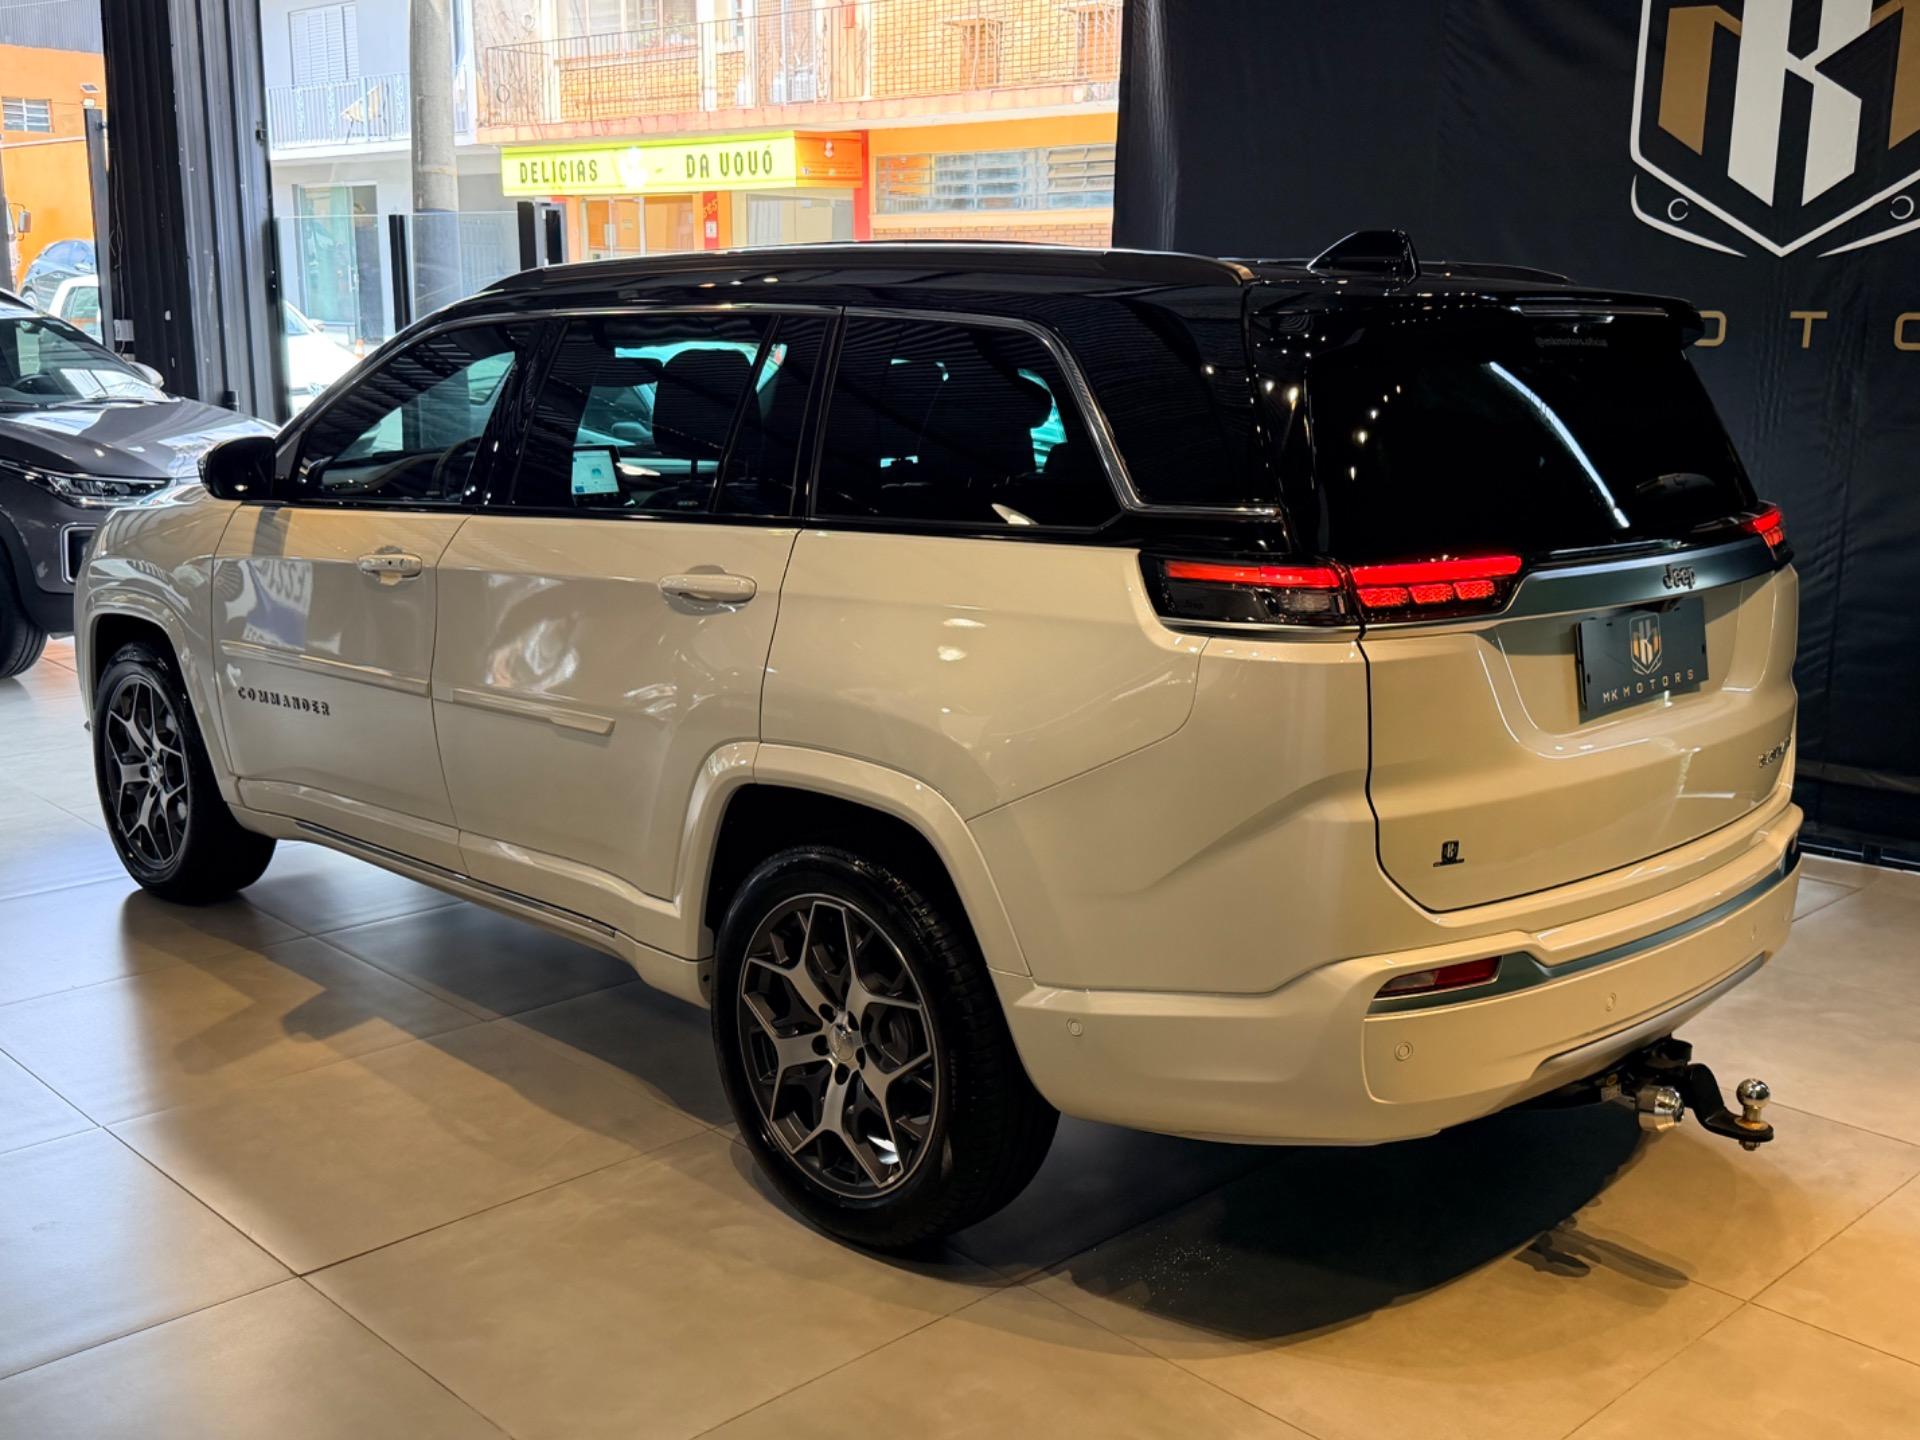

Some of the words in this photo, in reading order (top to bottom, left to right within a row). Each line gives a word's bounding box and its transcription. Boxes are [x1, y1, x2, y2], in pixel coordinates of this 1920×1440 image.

[520, 160, 598, 184] DELICIAS
[686, 153, 709, 178] DA
[1663, 564, 1696, 589] Jeep
[238, 686, 331, 716] COMMANDER
